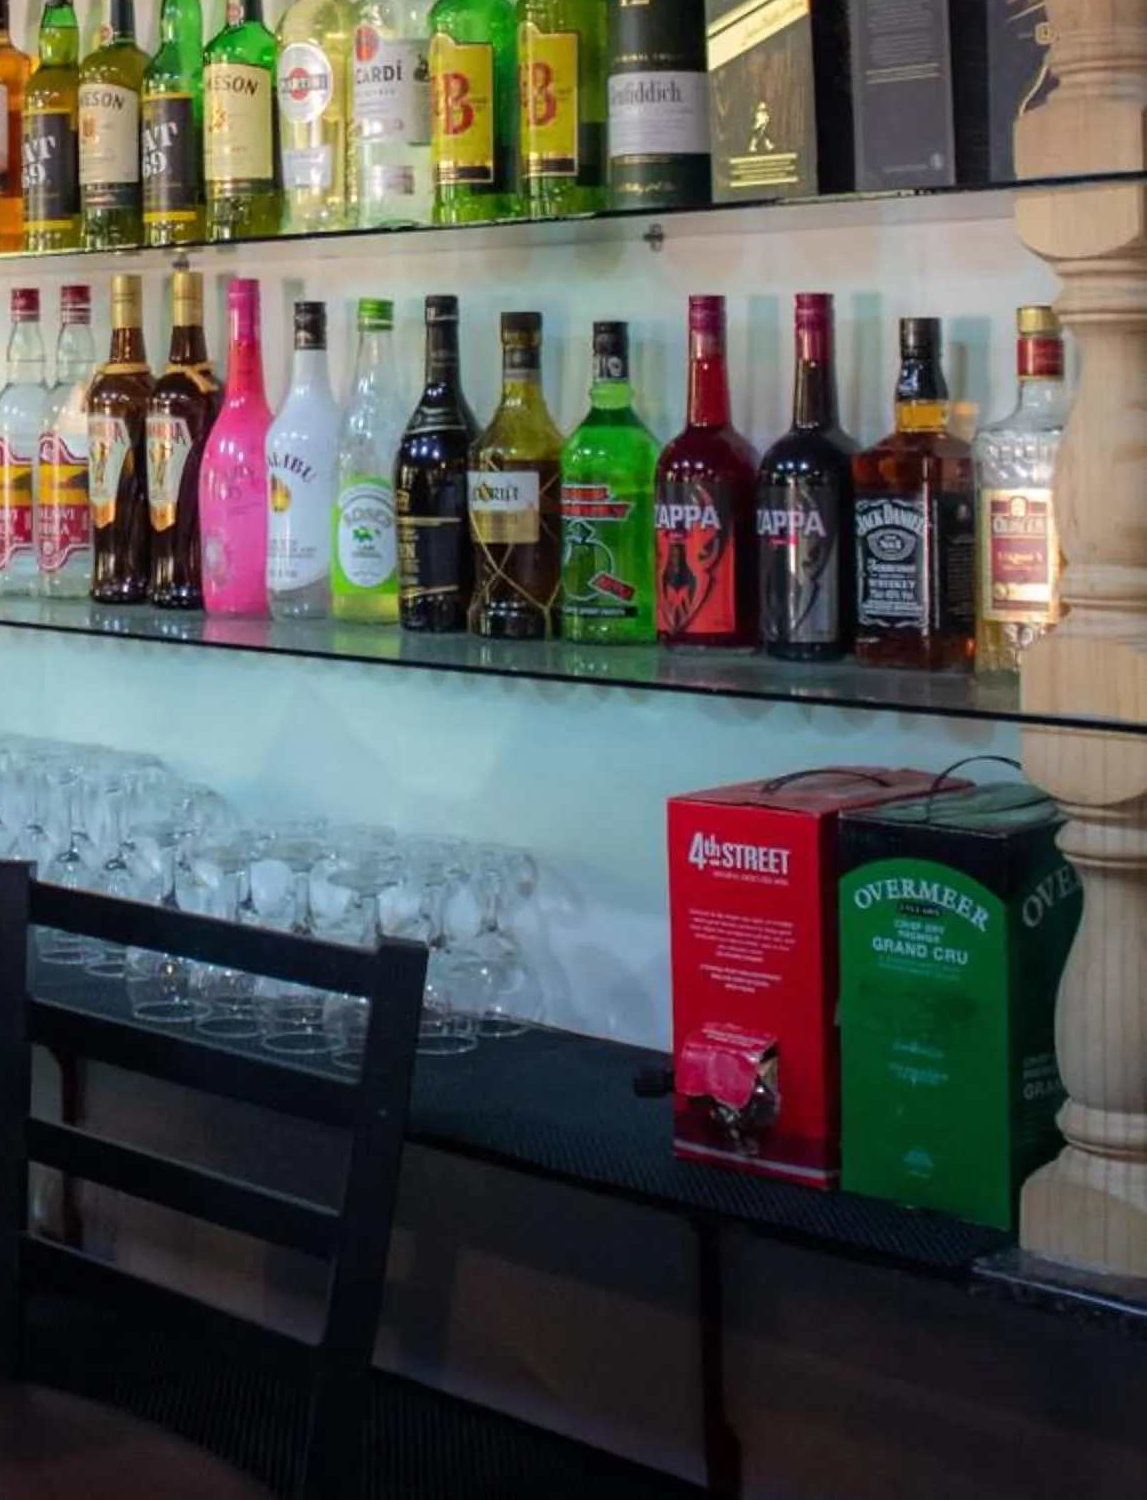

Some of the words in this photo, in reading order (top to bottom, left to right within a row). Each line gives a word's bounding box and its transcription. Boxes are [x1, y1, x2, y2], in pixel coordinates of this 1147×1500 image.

[81, 91, 125, 110] ESON
[721, 842, 790, 875] STREET
[854, 877, 990, 933] OVERMEER
[872, 934, 928, 959] GRAND
[932, 946, 969, 966] CRU
